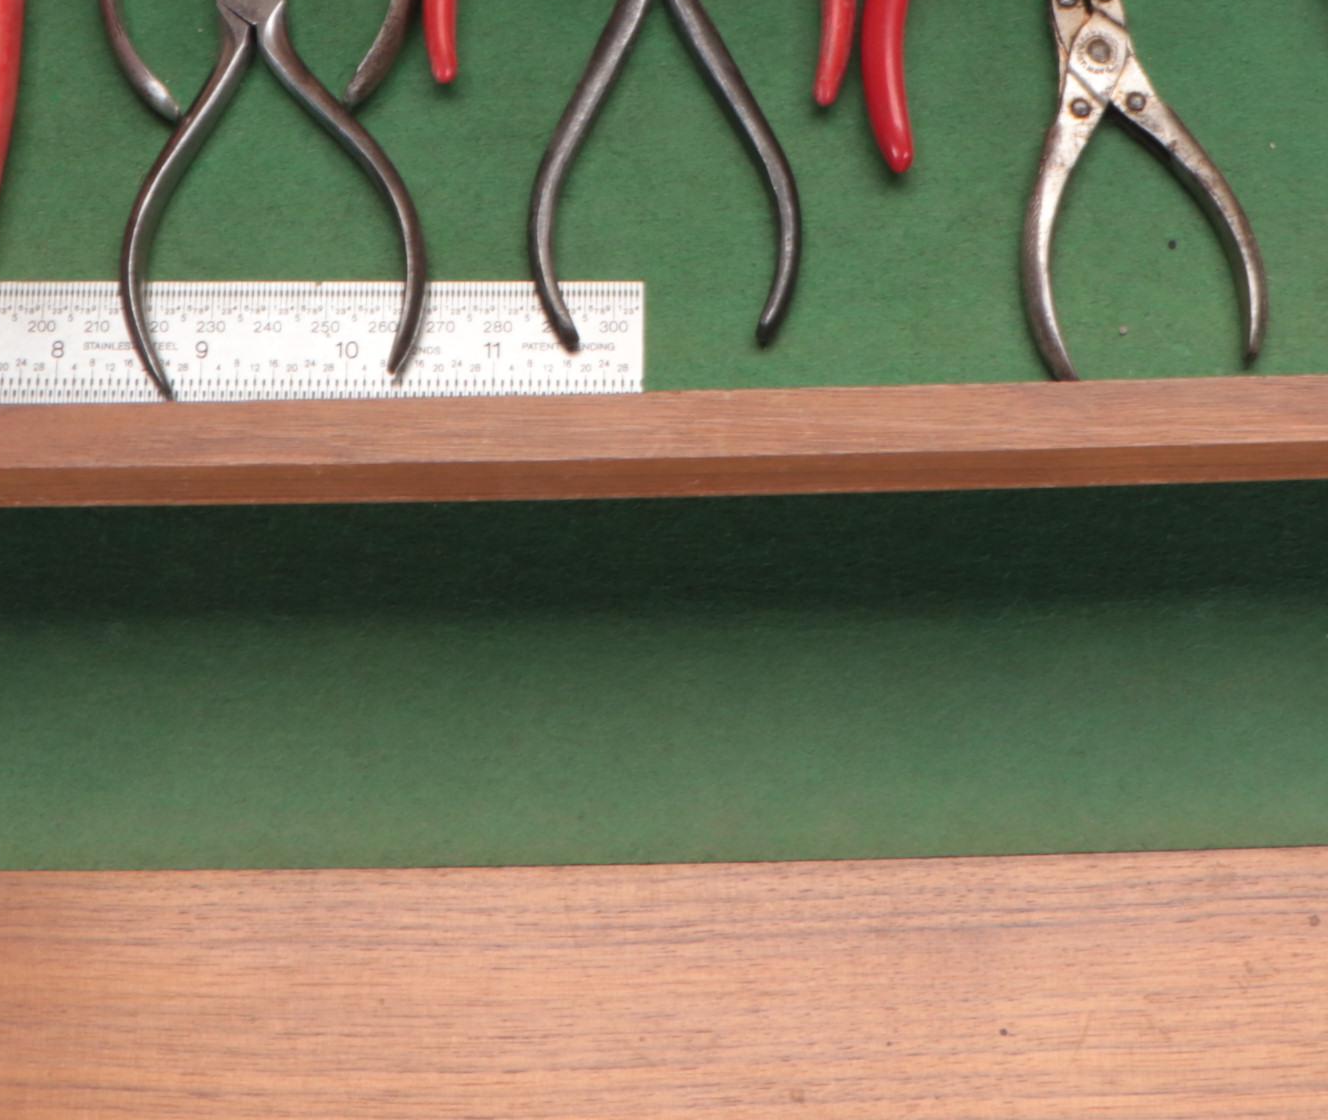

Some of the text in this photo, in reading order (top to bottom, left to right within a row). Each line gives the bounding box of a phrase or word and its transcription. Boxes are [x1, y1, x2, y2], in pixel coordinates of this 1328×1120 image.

[28, 320, 56, 334] 200
[84, 320, 110, 334] 210
[196, 320, 226, 334] 230
[253, 320, 282, 334] 240
[310, 320, 341, 334] 250
[368, 320, 398, 334] 260
[426, 320, 456, 334] 270
[483, 320, 513, 334] 280
[599, 320, 629, 334] 300
[50, 340, 66, 360] 8
[83, 340, 136, 352] STAINLES
[194, 340, 360, 360] 9 10
[484, 341, 502, 360] 11
